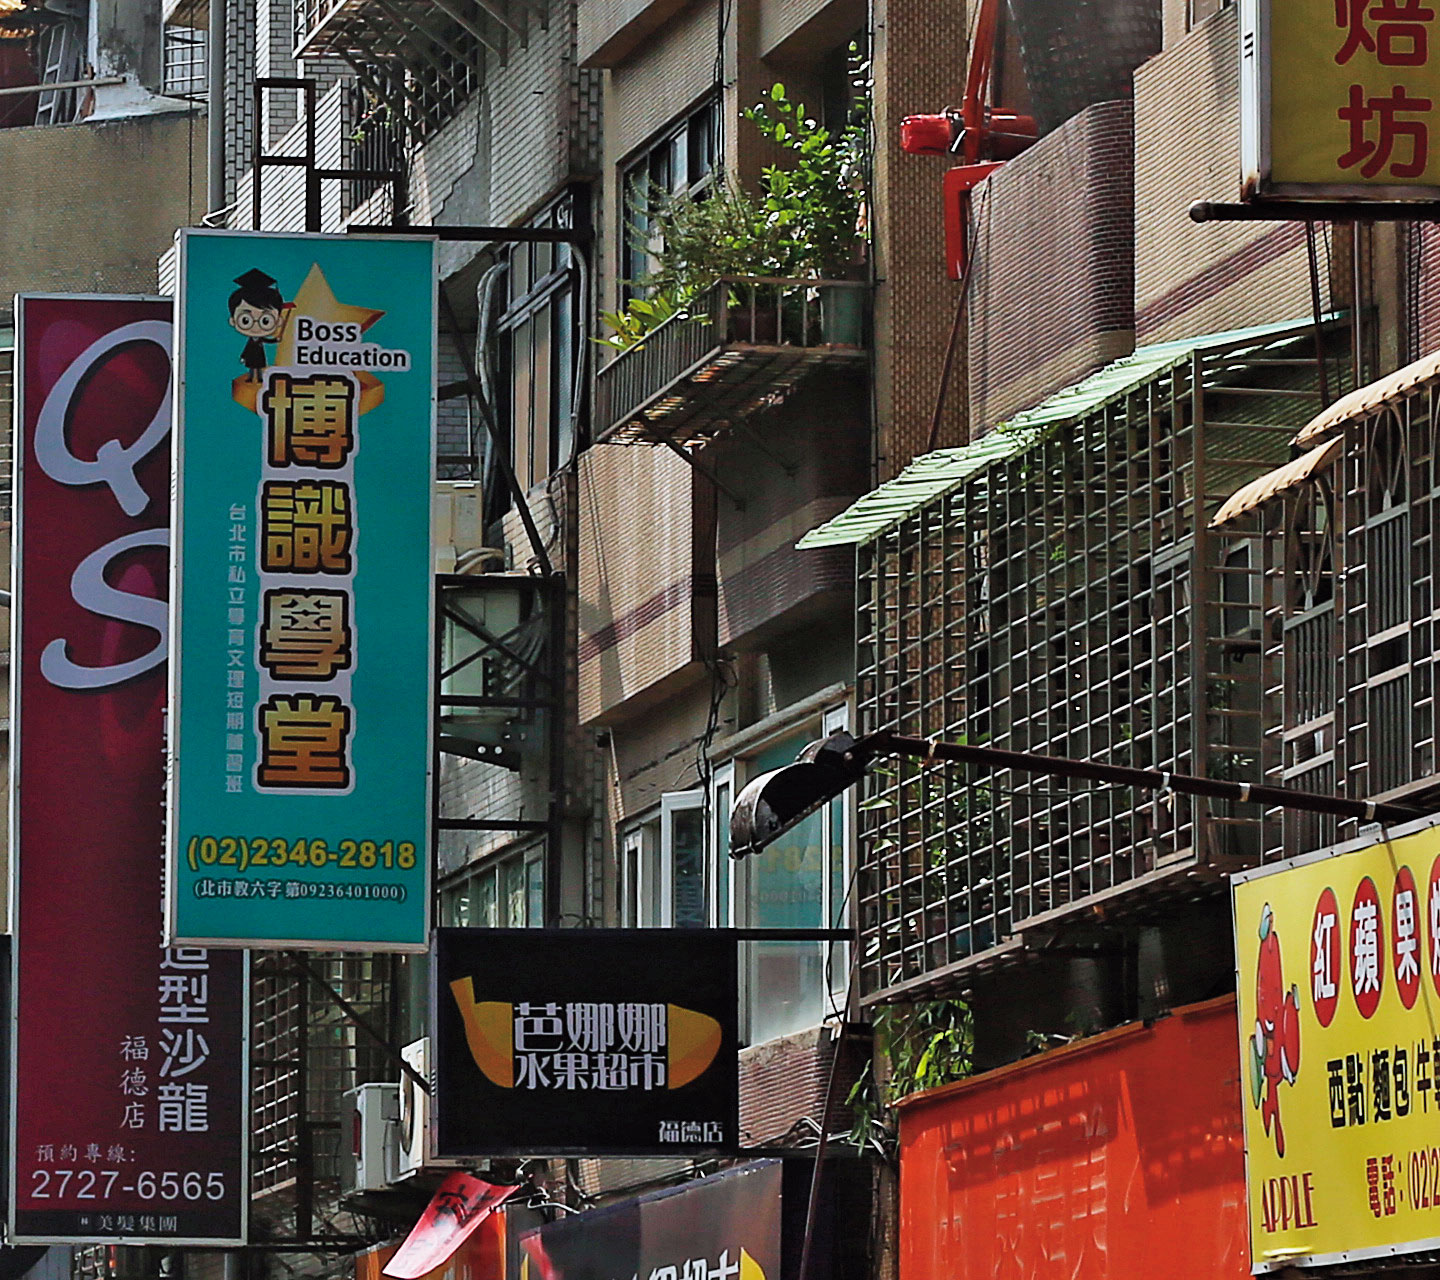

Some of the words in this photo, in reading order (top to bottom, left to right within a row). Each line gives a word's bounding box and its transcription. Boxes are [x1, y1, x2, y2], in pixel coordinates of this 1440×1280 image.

[297, 319, 358, 343] Boss
[297, 345, 407, 368] Education
[260, 373, 356, 791] 博識學堂
[187, 836, 416, 871] (02)2346-2818
[513, 1002, 667, 1053] 芭娜娜
[120, 1034, 150, 1130] 福德店
[513, 1052, 667, 1091] 水果超市
[658, 1120, 724, 1144] 福德店
[30, 1169, 225, 1201] 2727-6565
[1259, 1171, 1318, 1234] APPLE
